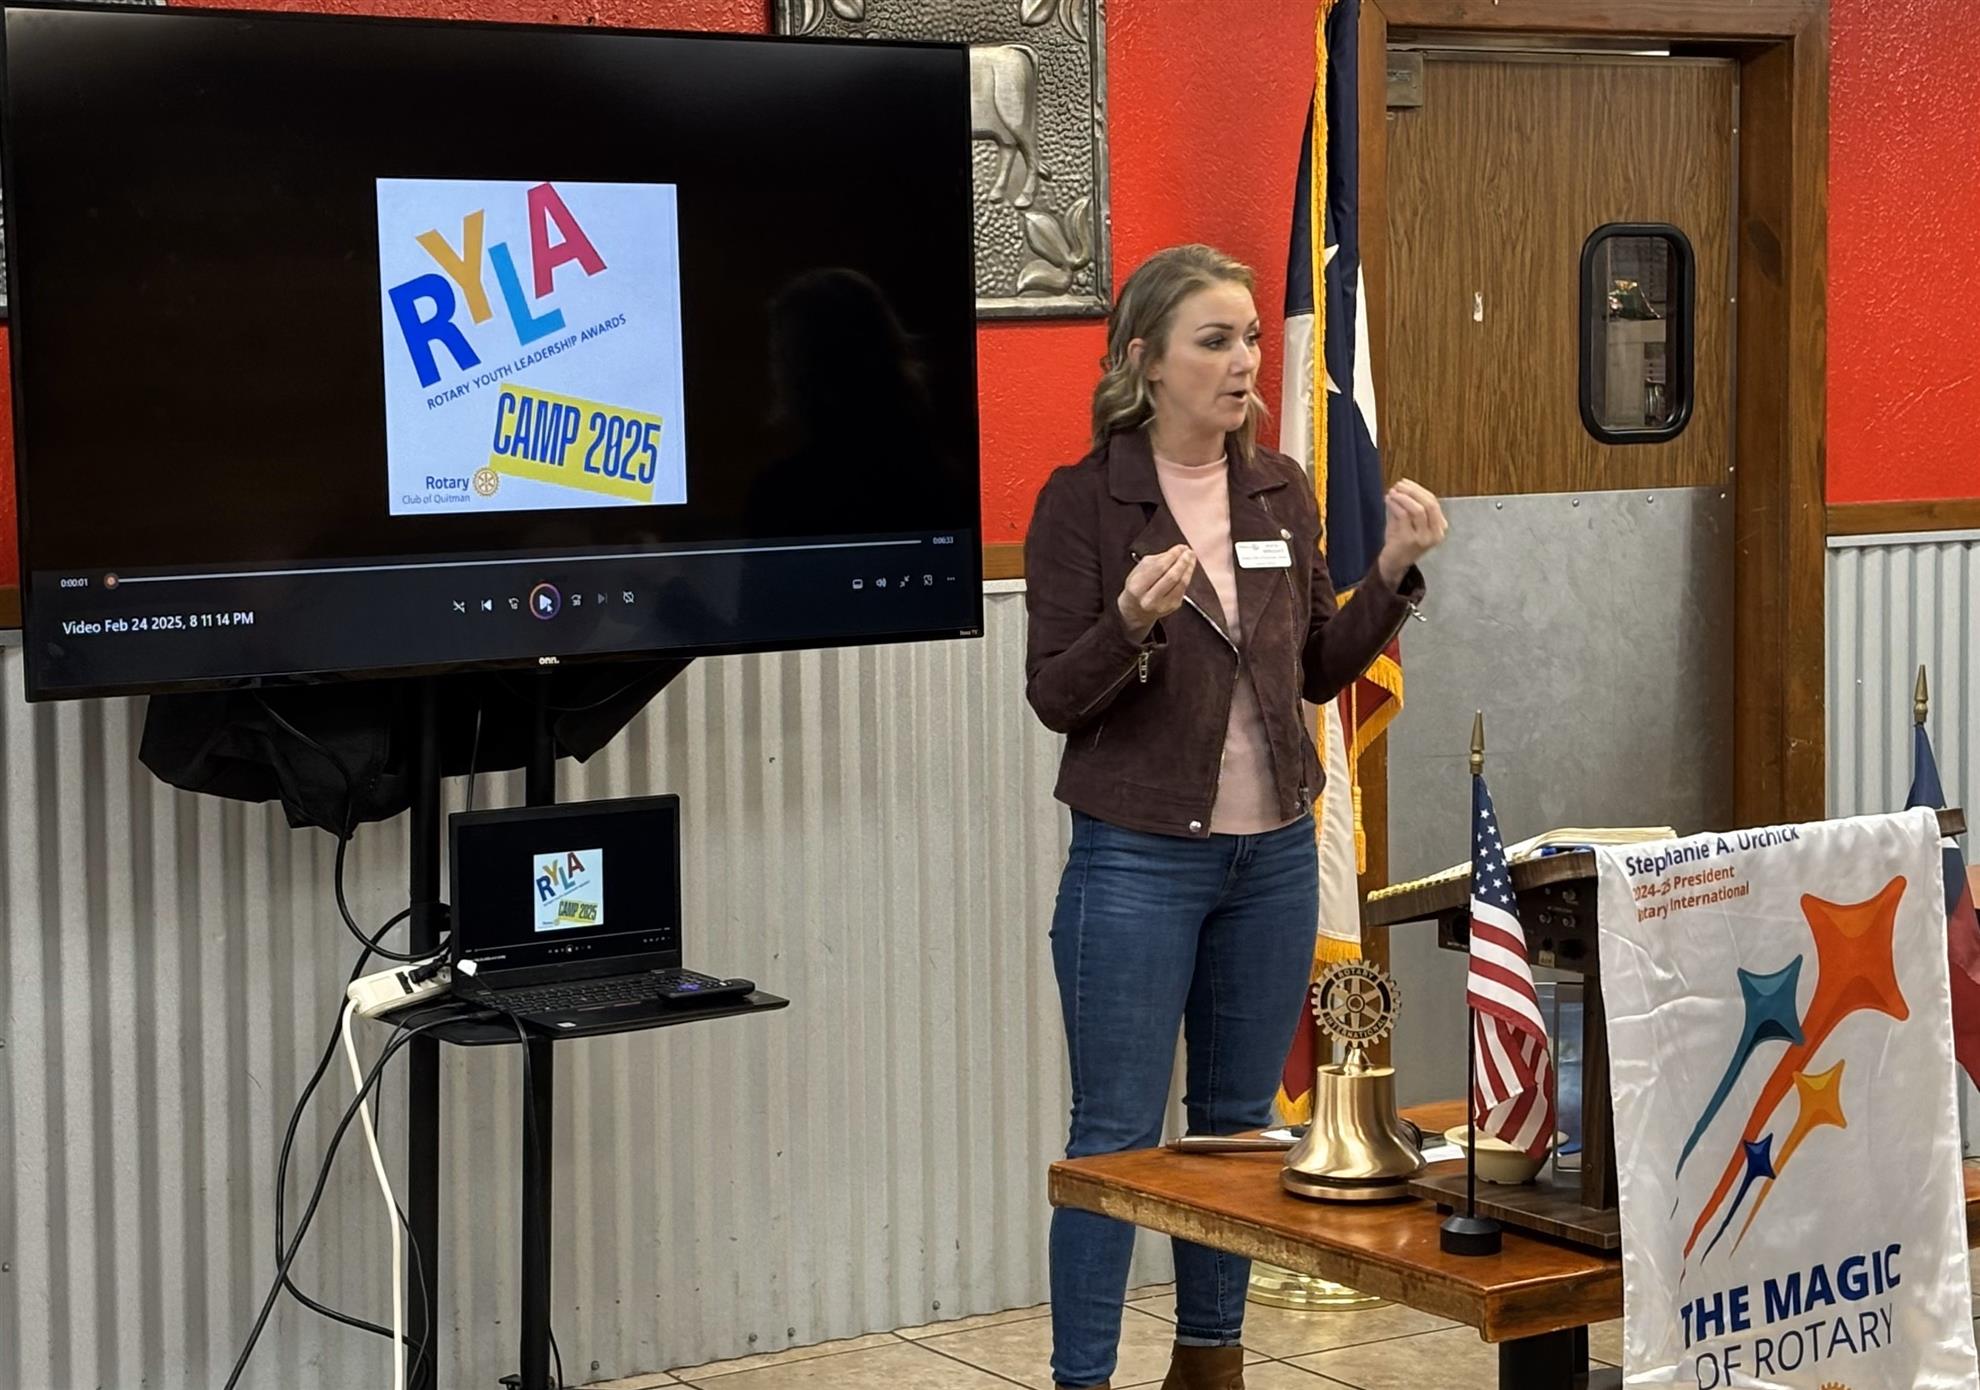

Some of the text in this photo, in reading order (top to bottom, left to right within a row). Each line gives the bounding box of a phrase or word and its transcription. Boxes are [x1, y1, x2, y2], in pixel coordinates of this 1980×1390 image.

[388, 182, 608, 388] RYLA
[427, 313, 627, 410] ROTARY YOUTH LEADERSHIP AWARDS
[493, 392, 661, 484] CAMP 2025
[402, 494, 471, 504] Club of Quitman
[426, 476, 470, 491] Rotary
[60, 578, 88, 587] 0:00:01
[63, 612, 254, 635] Video Feb 24 2025, 8 11 14 PM
[1625, 825, 1800, 877] Stephanie A. Urchick
[536, 852, 585, 902] RYLA
[1633, 865, 1735, 901] 024-25 President
[558, 901, 598, 921] CAMP 2025
[1638, 881, 1750, 923] tary International
[1338, 967, 1375, 979] ROTARY
[1325, 1014, 1387, 1039] INTERNATIONAL
[1680, 1243, 1902, 1349] THE MAGIC
[1696, 1302, 1893, 1390] OF ROTARY
